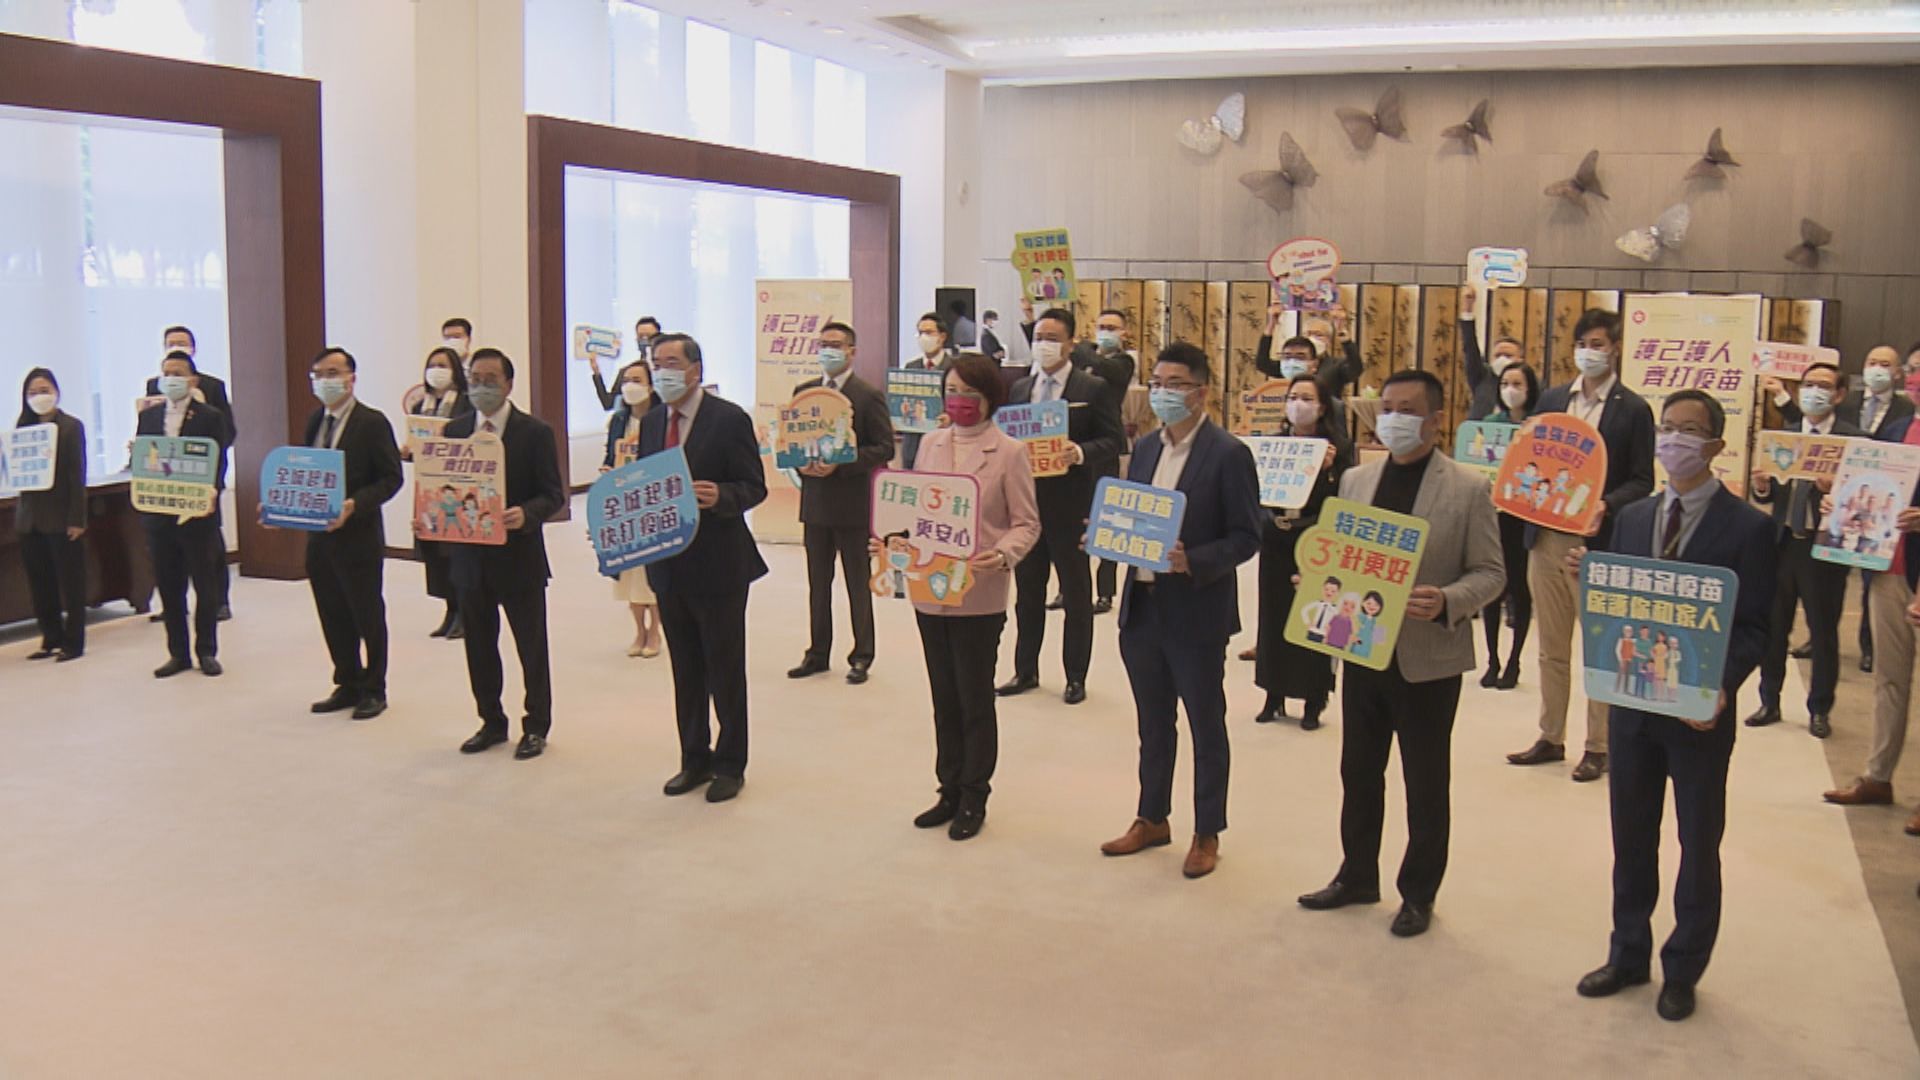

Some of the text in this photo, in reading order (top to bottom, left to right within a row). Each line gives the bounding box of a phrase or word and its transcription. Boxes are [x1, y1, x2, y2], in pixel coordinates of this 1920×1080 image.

[1632, 338, 1731, 363] 護己護人
[1641, 365, 1744, 391] 齊打疫苗
[603, 474, 684, 520] 全城起動
[599, 505, 678, 550] 快打疫苗
[916, 518, 970, 547] 更安心
[1335, 511, 1421, 553] 特定群組
[1588, 562, 1725, 604] 接種新冠疫苗
